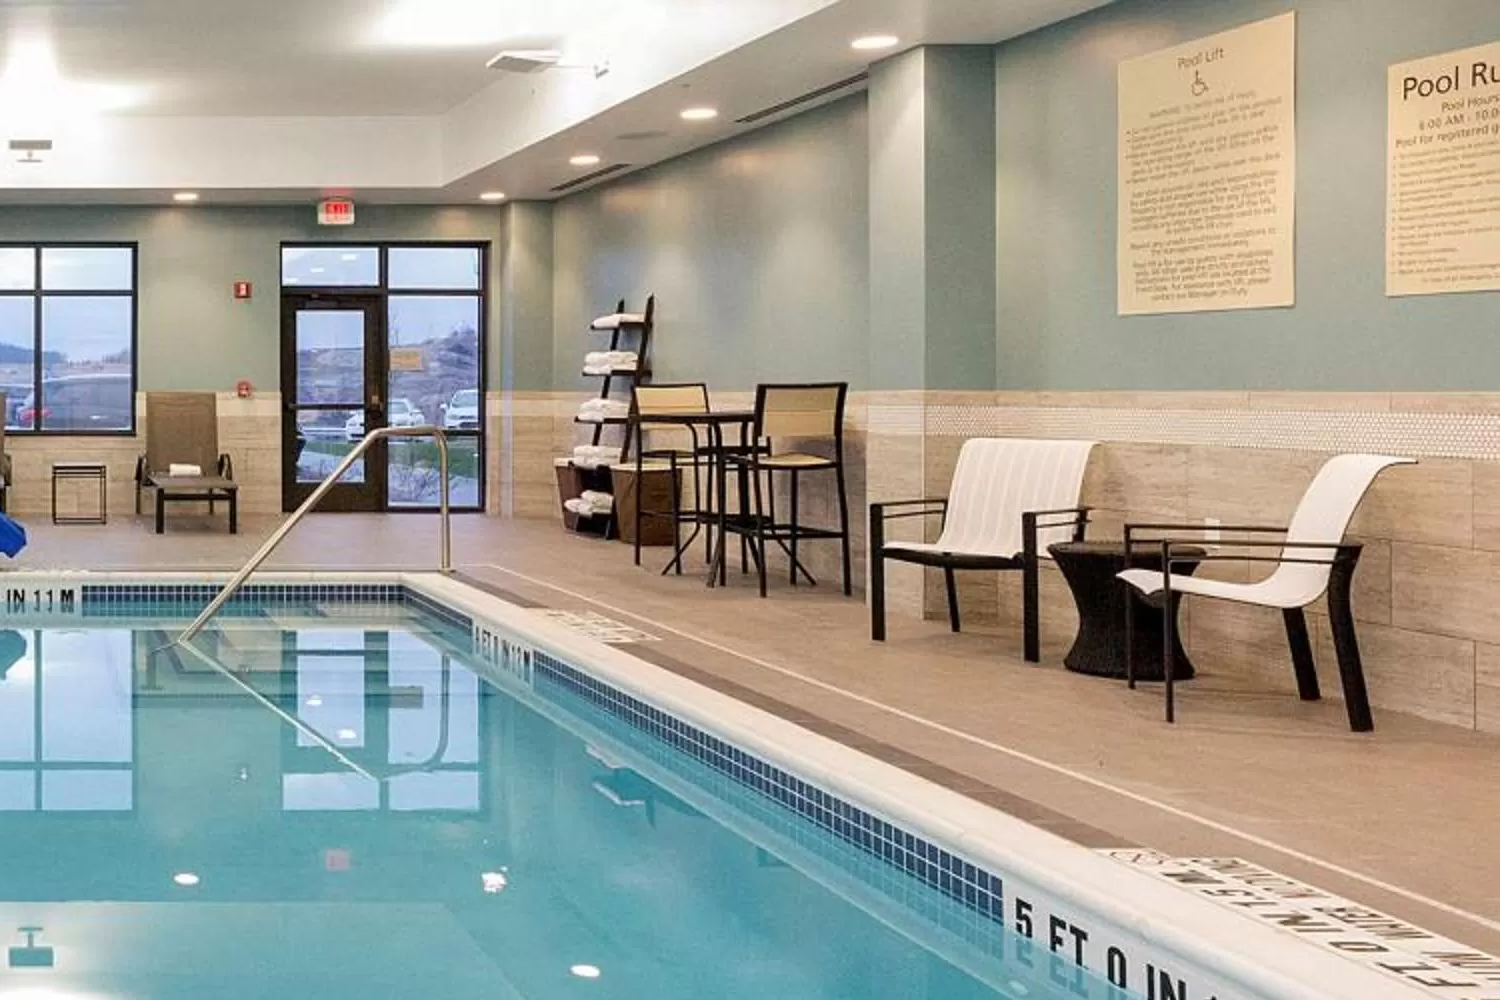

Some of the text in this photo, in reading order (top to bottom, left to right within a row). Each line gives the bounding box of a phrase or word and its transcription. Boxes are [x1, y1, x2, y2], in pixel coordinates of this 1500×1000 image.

[1204, 47, 1225, 64] Lift
[1402, 65, 1459, 101] Pool
[6, 588, 26, 604] IN
[60, 588, 76, 604] M
[1014, 896, 1034, 940] 5
